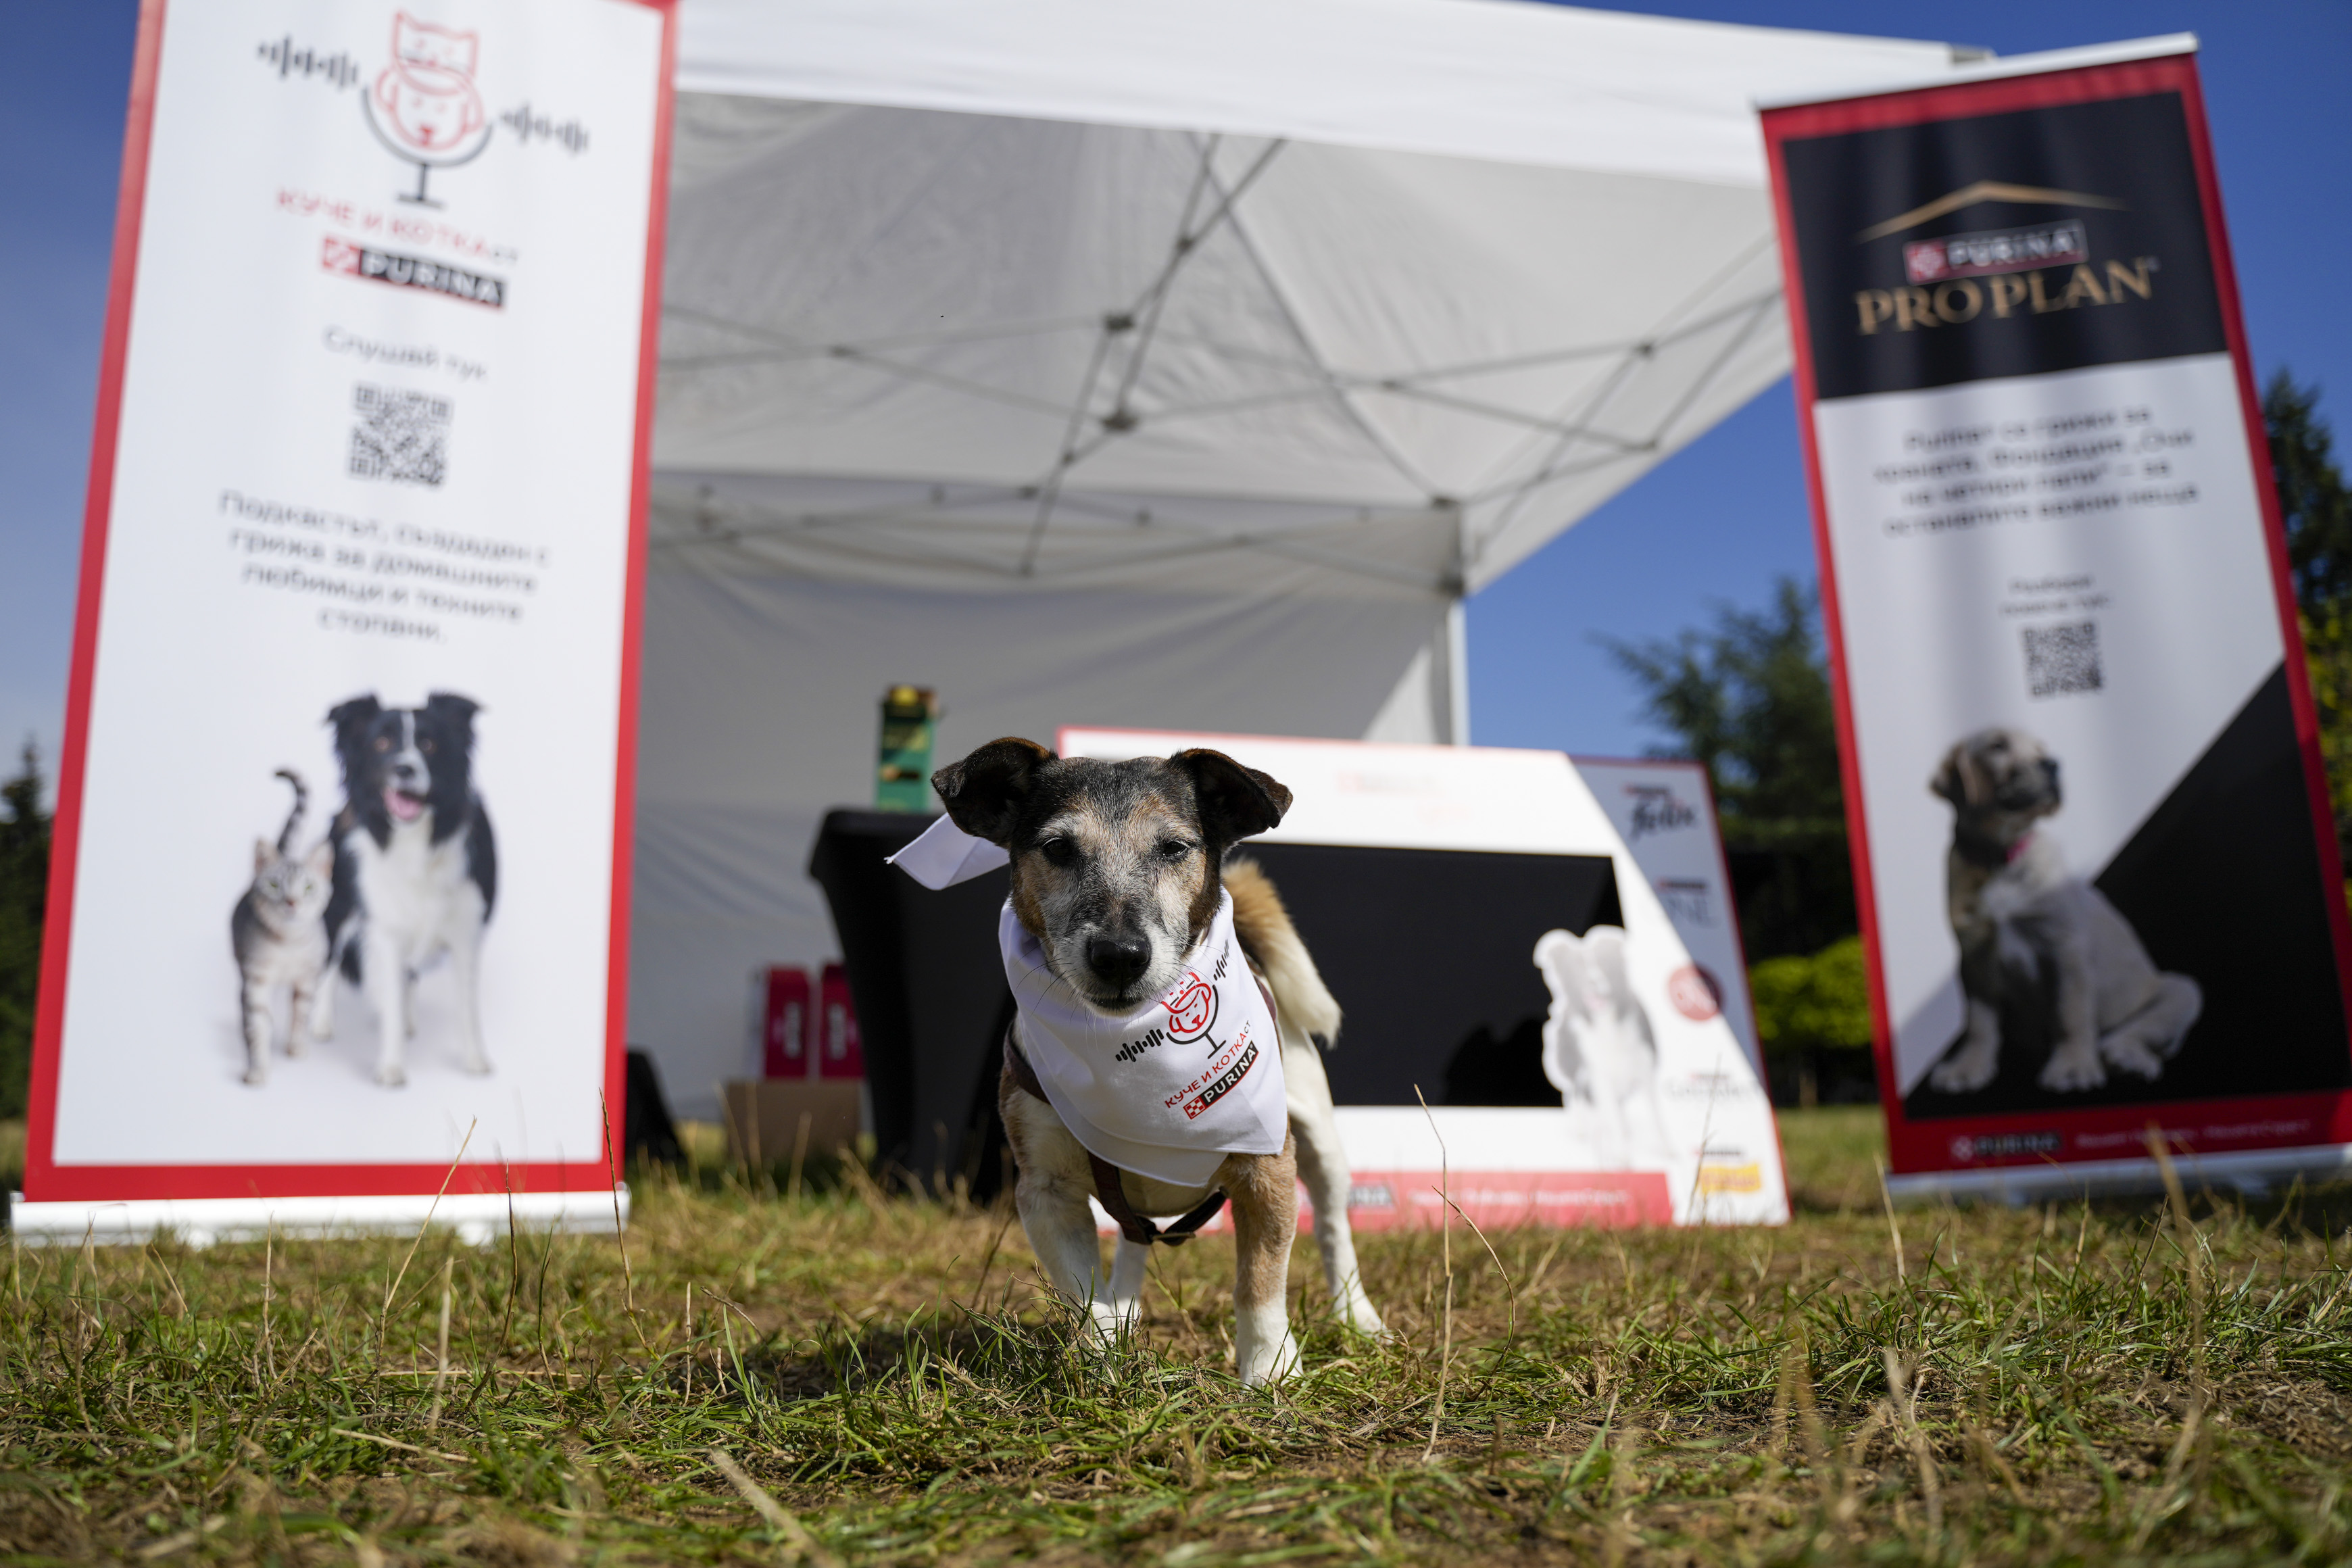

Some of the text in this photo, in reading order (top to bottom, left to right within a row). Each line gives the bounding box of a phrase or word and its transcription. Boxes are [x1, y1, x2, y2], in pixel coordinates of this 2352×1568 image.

[276, 187, 355, 226] КУЧЕ
[389, 217, 491, 261] КОТКА
[1948, 226, 2076, 268] PURINA
[362, 249, 503, 304] PURINA
[1165, 1080, 1201, 1108] КУЧЕ
[1201, 1071, 1212, 1083] И
[1212, 1032, 1247, 1074] КОТКА
[1204, 1047, 1256, 1103] PURINA
